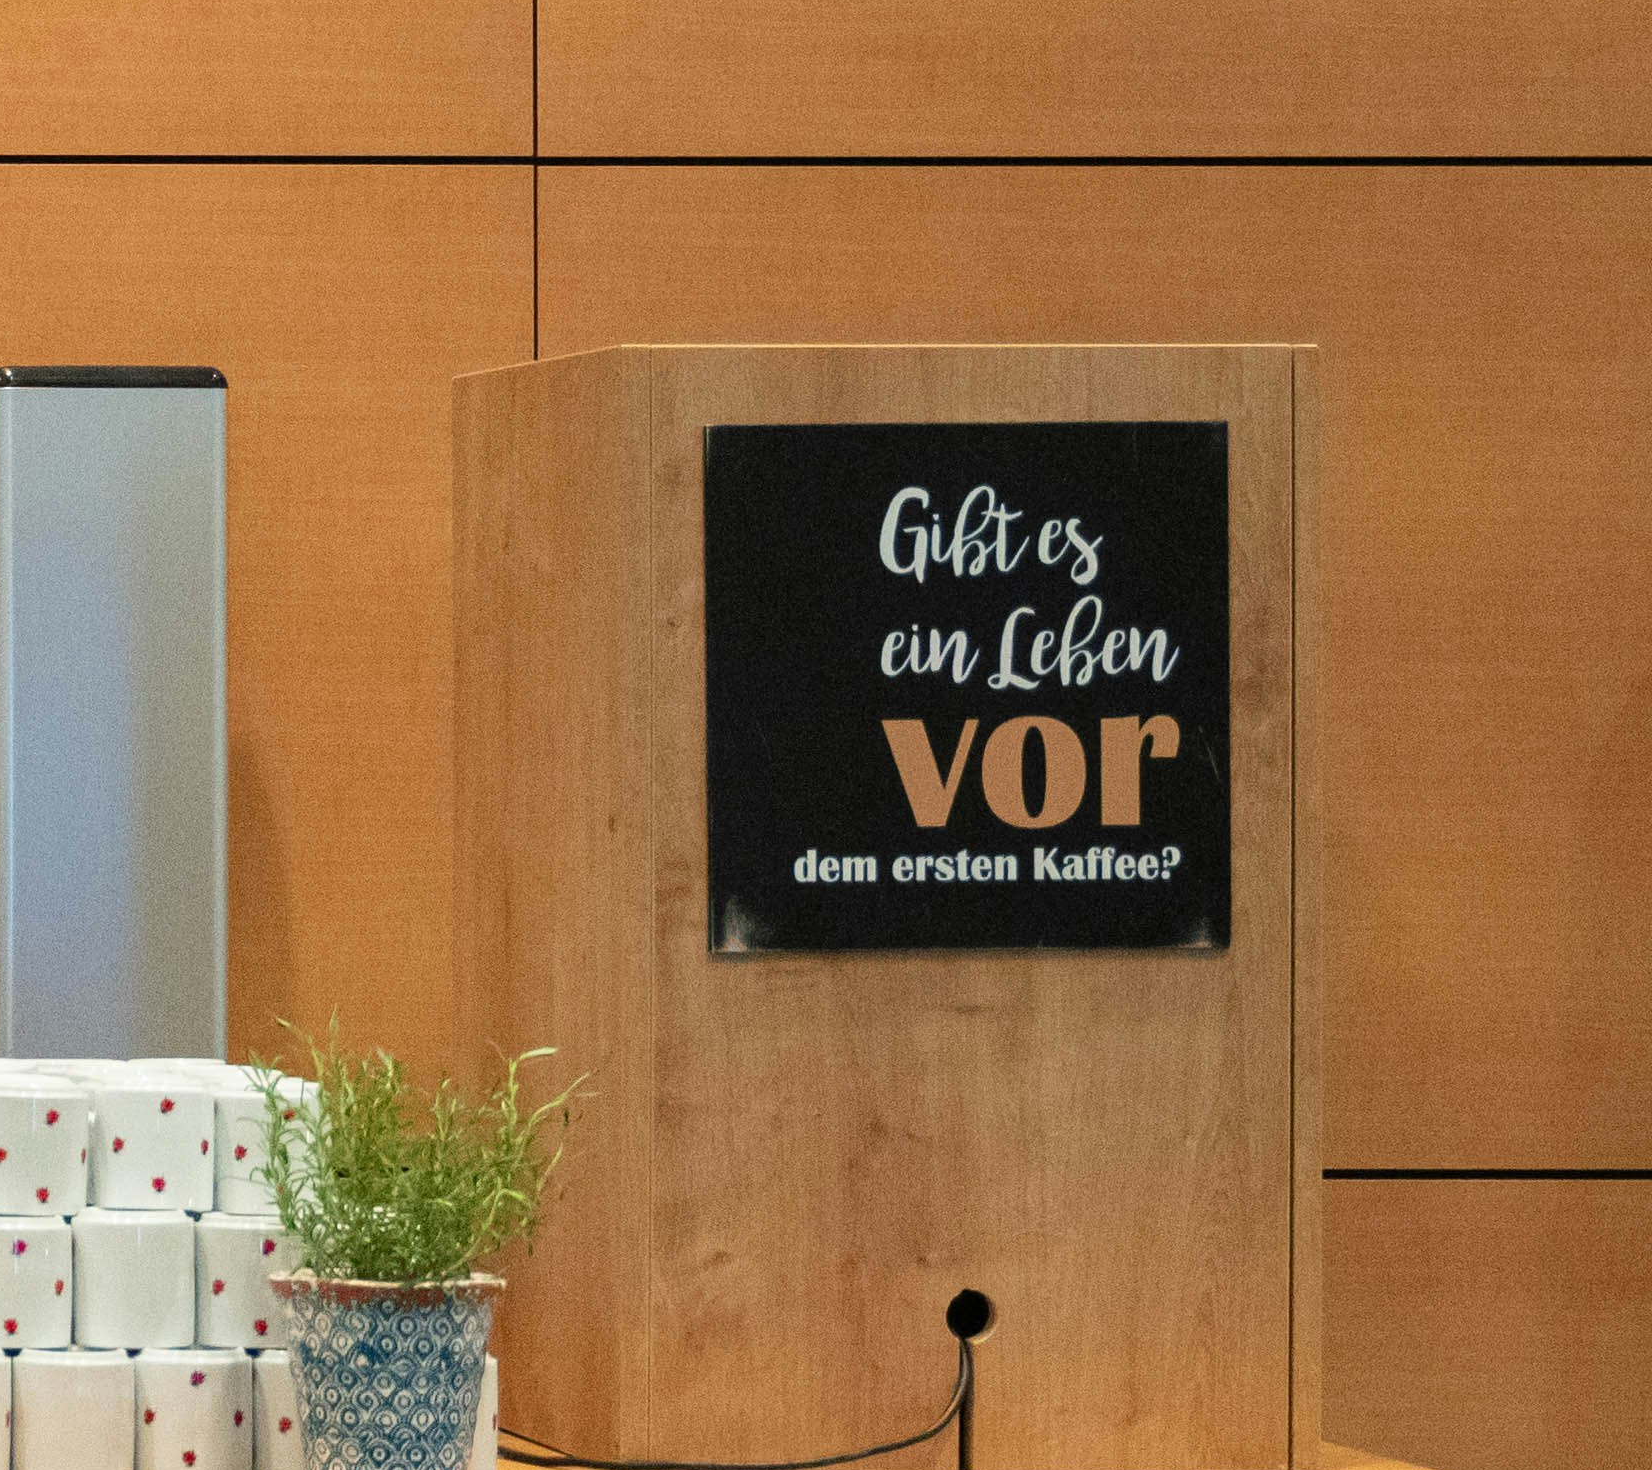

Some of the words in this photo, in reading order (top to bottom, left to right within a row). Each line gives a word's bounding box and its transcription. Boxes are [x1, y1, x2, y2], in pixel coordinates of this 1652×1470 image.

[879, 485, 1030, 584] Gibt
[1037, 518, 1104, 586] es
[880, 624, 980, 684] ein
[988, 595, 1180, 691] Leben
[881, 714, 1180, 829] vor
[793, 849, 877, 884] dem
[892, 849, 1018, 882] ersten
[1033, 846, 1182, 882] Kaffee?
